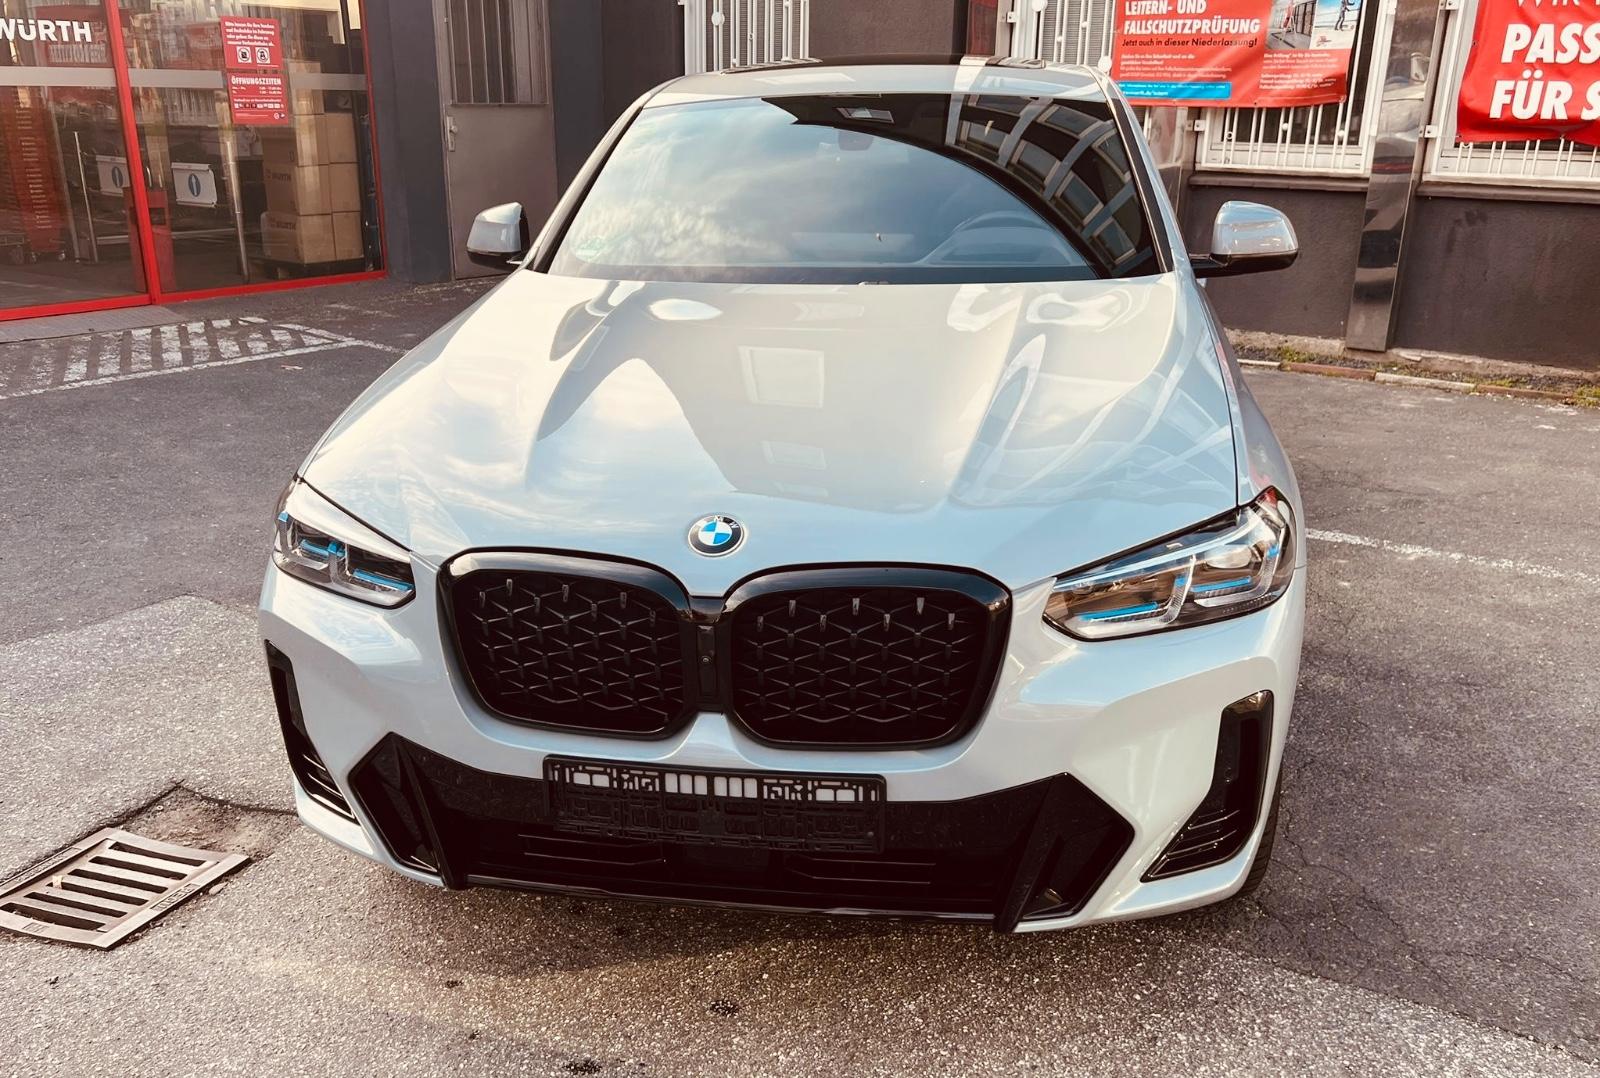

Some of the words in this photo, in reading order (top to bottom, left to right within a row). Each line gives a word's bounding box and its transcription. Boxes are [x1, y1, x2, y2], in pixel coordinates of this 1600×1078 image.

[1125, 0, 1173, 15] LEITERN-
[1177, 0, 1207, 14] UND
[0, 18, 92, 43] WÜRTH
[1123, 15, 1261, 35] FALLSCHUTZPRÜFUNG
[1122, 39, 1138, 47] Jetzt
[1138, 38, 1155, 47] auch
[1156, 38, 1163, 46] in
[1164, 38, 1190, 47] dieser
[1191, 37, 1258, 48] Niederlassung!
[231, 75, 282, 86] ÖFFNUNGSZEITEN
[1489, 69, 1573, 120] FÜR
